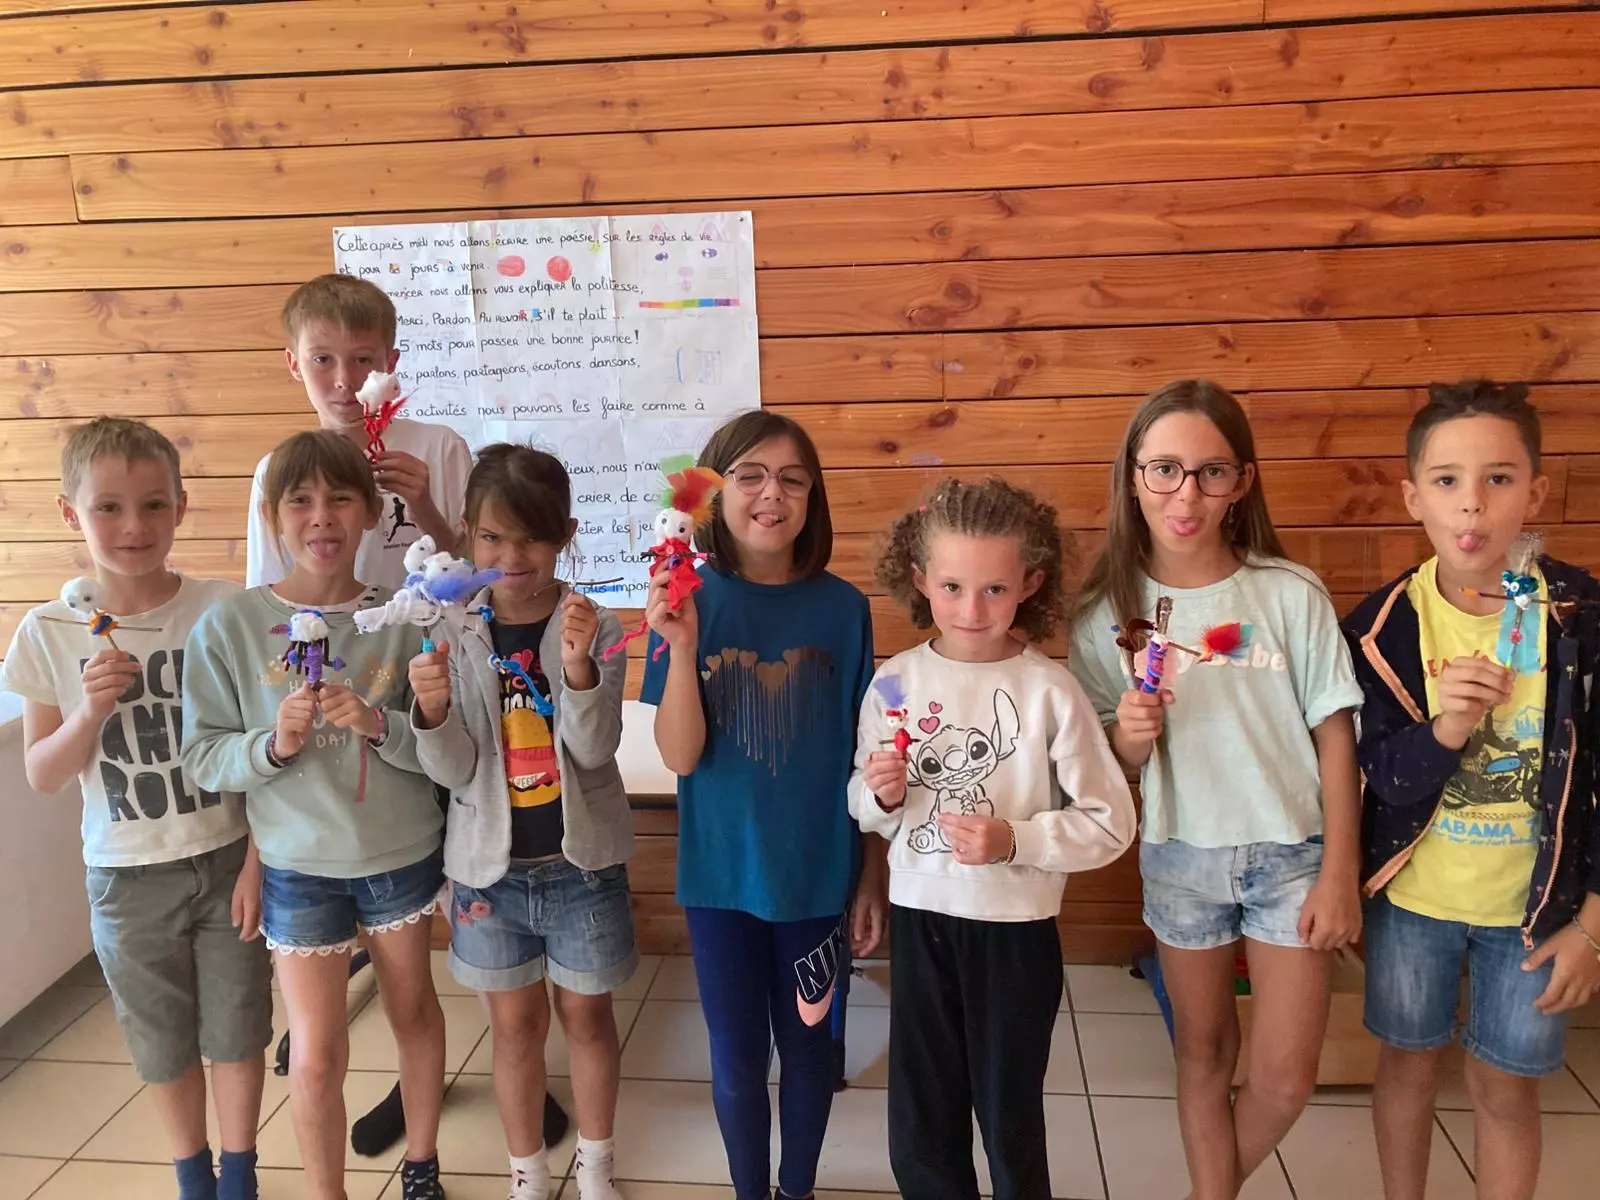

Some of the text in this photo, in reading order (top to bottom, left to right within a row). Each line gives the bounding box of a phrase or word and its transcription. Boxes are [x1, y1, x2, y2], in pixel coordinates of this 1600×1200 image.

[434, 239, 454, 248] nous
[460, 236, 490, 247] allons
[626, 230, 641, 242] les
[681, 231, 694, 242] de
[338, 264, 351, 274] et
[359, 266, 381, 280] pour
[447, 261, 455, 272] à
[430, 288, 448, 296] nous
[454, 284, 488, 296] allons
[494, 284, 514, 295] vous
[519, 280, 566, 298] expliquer
[571, 277, 582, 291] la
[562, 308, 574, 321] te
[400, 340, 410, 352] 5
[416, 340, 442, 351] mots
[448, 341, 476, 358] pour
[526, 336, 546, 345] une
[552, 333, 584, 344] bonne
[416, 401, 468, 416] activités
[478, 405, 506, 416] nous
[512, 404, 563, 420] pouvons
[572, 399, 590, 413] les
[602, 396, 634, 420] faire
[642, 403, 687, 411] comme
[694, 398, 705, 411] à
[602, 463, 628, 472] nous
[620, 487, 638, 502] de
[612, 519, 630, 533] les
[594, 554, 616, 568] pas
[316, 731, 347, 748] DAY
